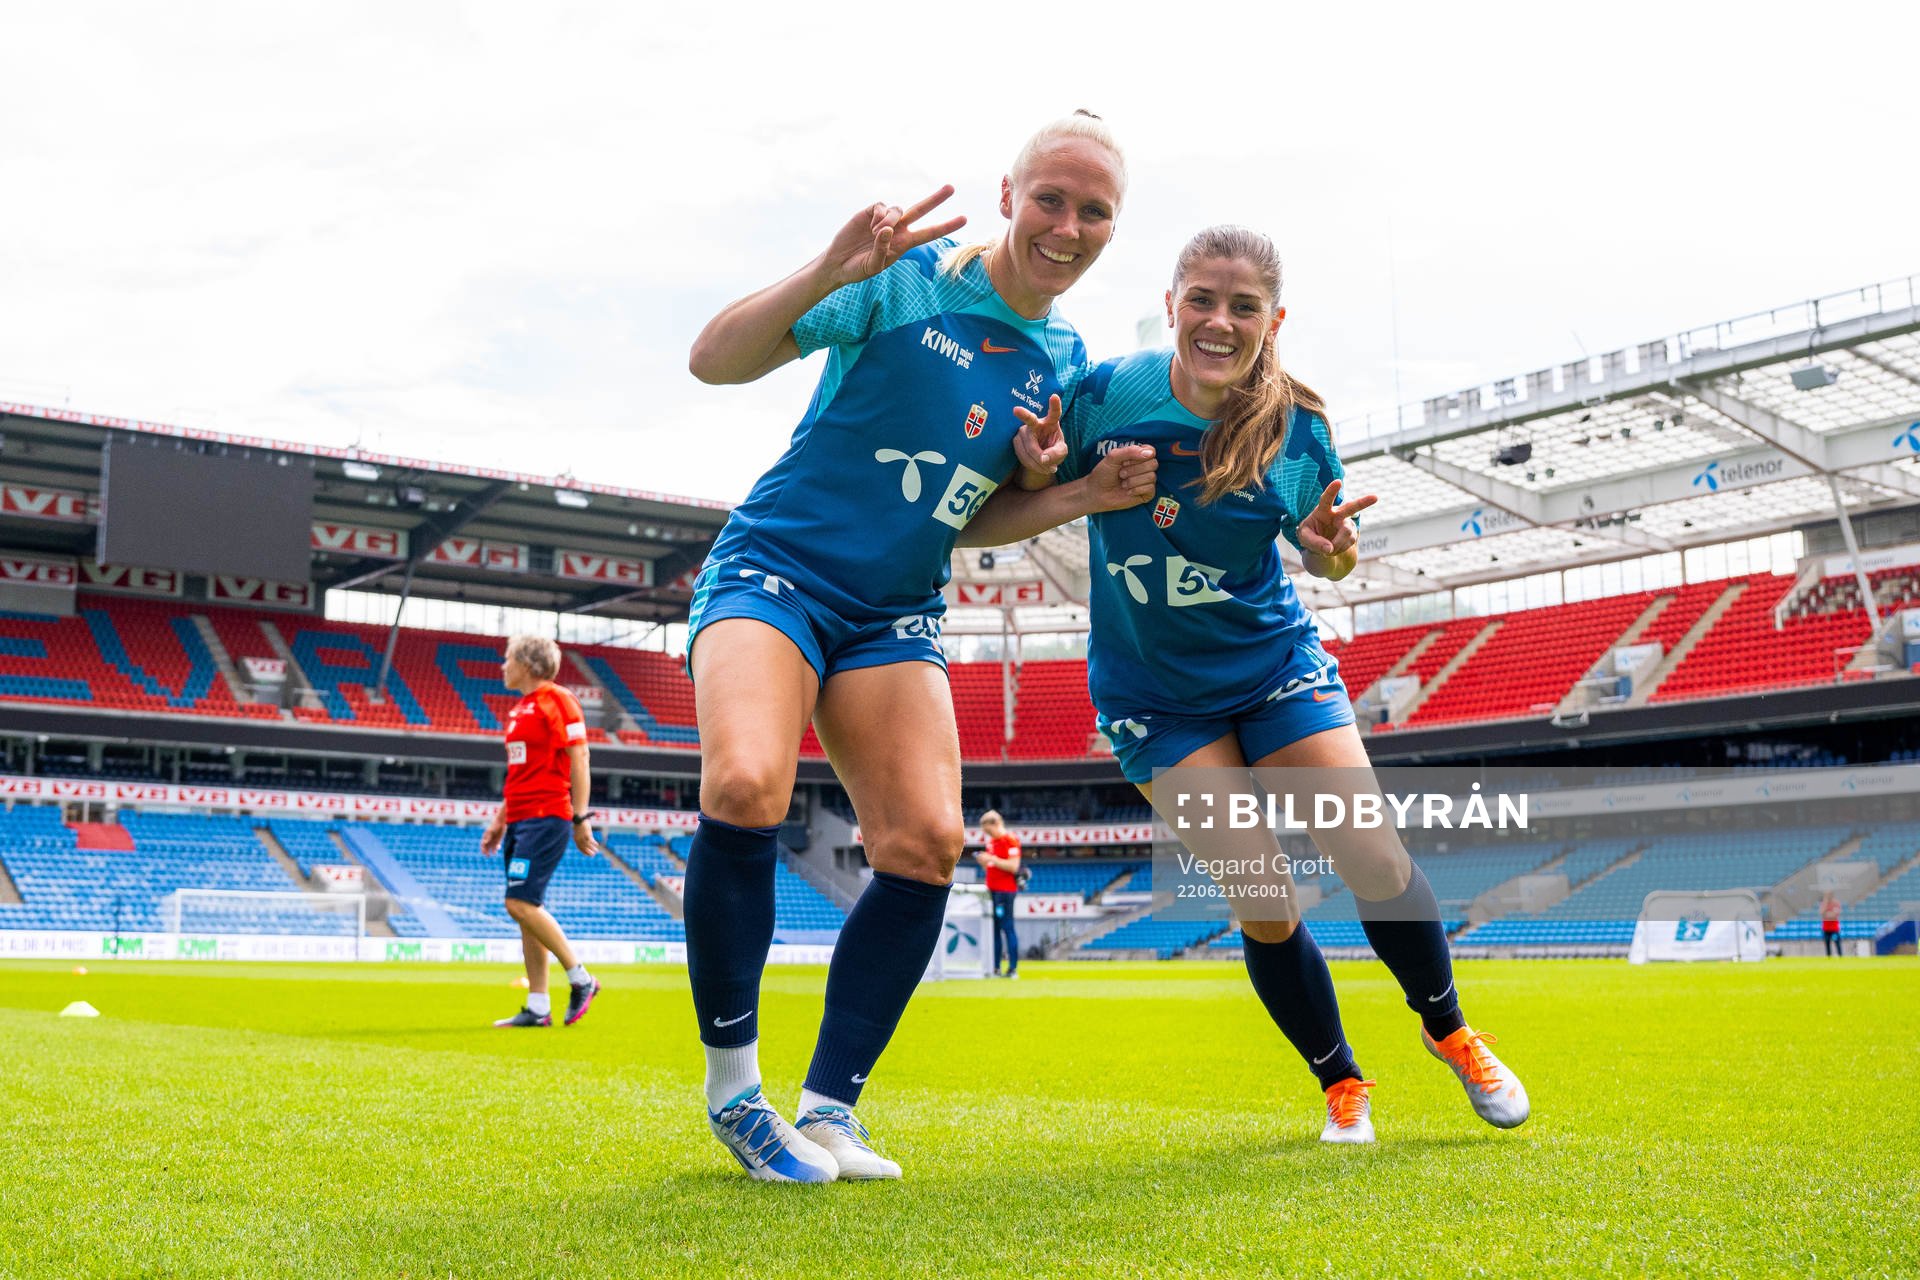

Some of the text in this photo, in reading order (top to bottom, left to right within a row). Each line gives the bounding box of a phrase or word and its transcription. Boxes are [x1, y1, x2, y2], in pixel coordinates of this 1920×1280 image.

[921, 326, 959, 361] KIWI
[959, 348, 974, 362] mini
[957, 356, 970, 369] pris
[1011, 387, 1027, 402] Norsk
[1720, 459, 1783, 484] telenor
[8, 488, 101, 518] VG
[311, 525, 395, 556] VG
[437, 538, 519, 569] VG
[1, 560, 71, 583] VG
[80, 563, 173, 592] VG
[564, 554, 643, 585] VG
[214, 577, 302, 602] VG
[958, 581, 1042, 604] VG
